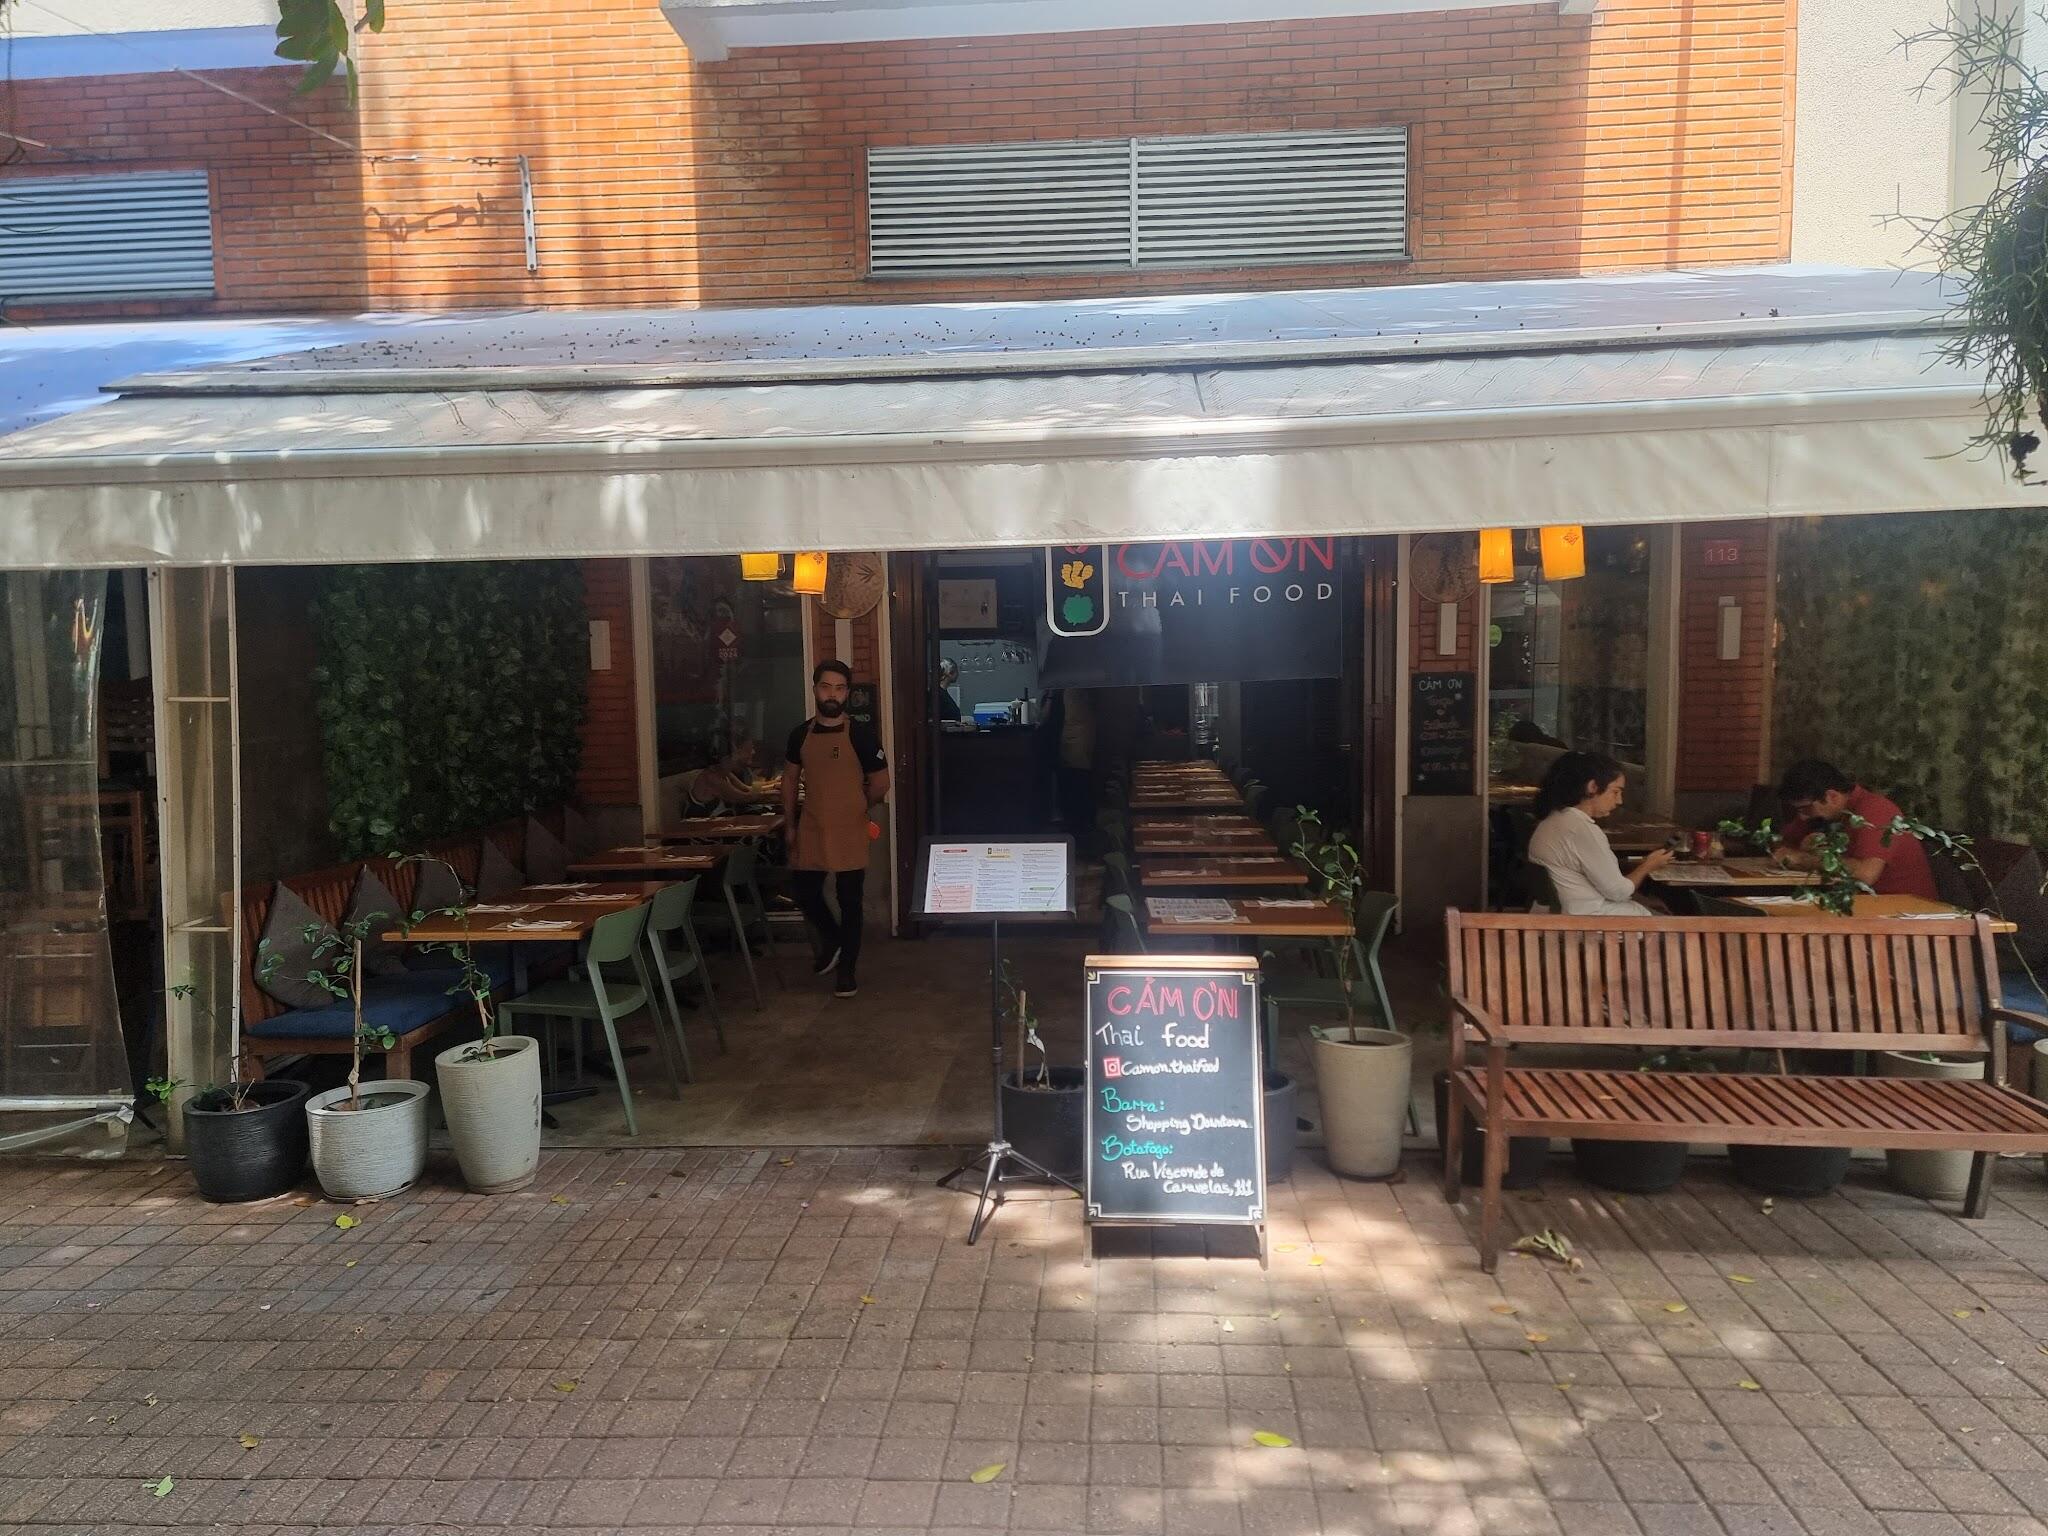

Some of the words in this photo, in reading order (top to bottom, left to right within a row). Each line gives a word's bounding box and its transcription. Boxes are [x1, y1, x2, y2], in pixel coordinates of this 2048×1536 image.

[1118, 589, 1203, 608] THAI
[1229, 583, 1334, 604] FOOD
[1095, 1022, 1144, 1046] Thai
[1100, 1088, 1165, 1112] Barra:
[1126, 1113, 1191, 1135] Shopping
[1100, 1136, 1173, 1160] Botafogo:
[1121, 1161, 1151, 1180] Rua
[1152, 1160, 1209, 1180] Visconde
[1210, 1161, 1225, 1178] de
